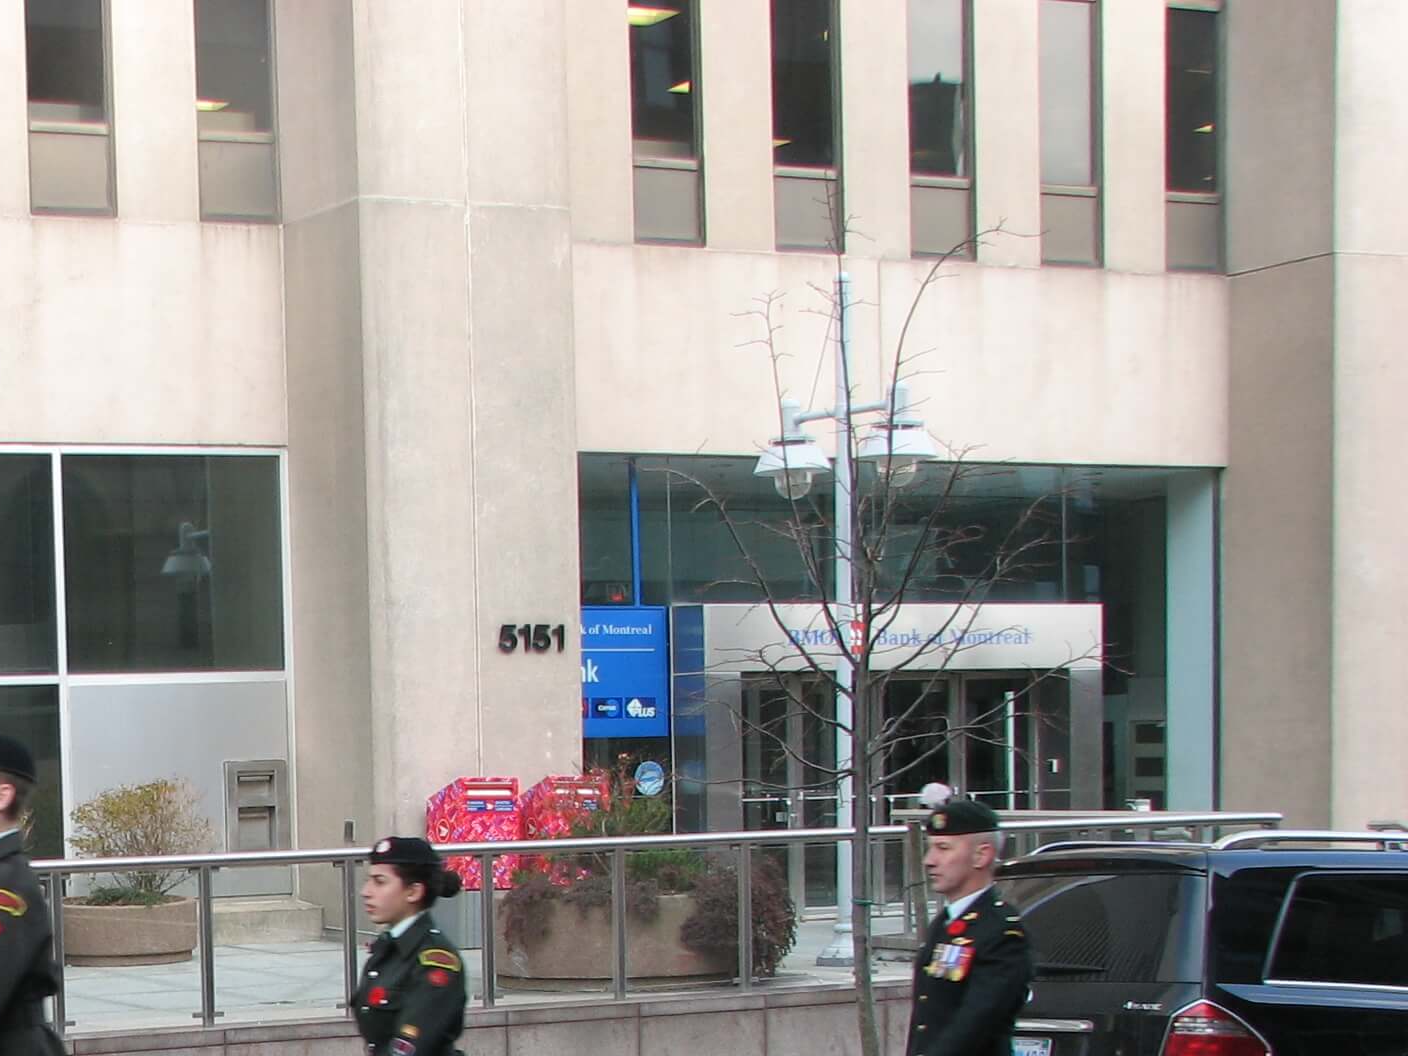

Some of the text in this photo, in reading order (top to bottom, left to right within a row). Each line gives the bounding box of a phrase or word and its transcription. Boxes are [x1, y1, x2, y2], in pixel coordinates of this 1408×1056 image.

[588, 624, 600, 634] of
[602, 624, 652, 634] Montreal
[788, 629, 838, 646] BMO
[878, 628, 922, 646] Bank
[950, 628, 1033, 646] Montreal
[498, 624, 565, 654] 5151
